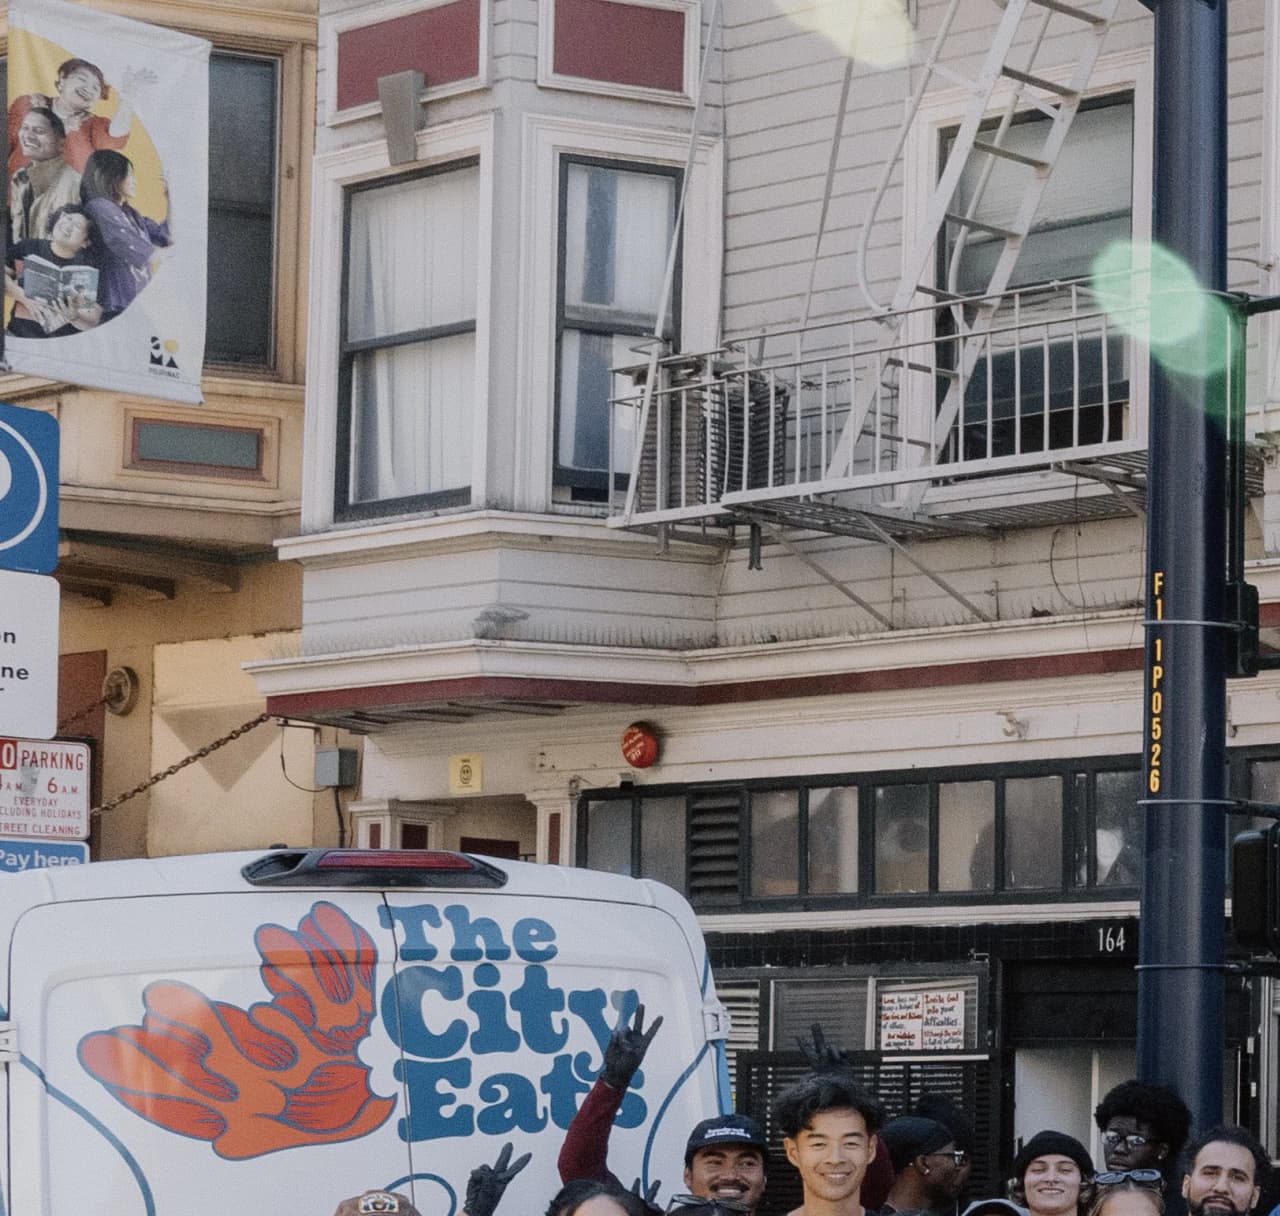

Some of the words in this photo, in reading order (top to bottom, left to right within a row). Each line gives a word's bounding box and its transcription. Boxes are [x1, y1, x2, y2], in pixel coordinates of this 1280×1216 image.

[0, 632, 16, 644] n
[1, 668, 29, 680] ne
[2, 746, 15, 768] O
[21, 750, 84, 770] PARKING
[47, 777, 58, 793] 6
[14, 796, 57, 807] EVERYDAY
[0, 807, 37, 818] CLUDING
[41, 809, 81, 820] HOLIDAYS
[0, 824, 28, 834] TREET
[32, 825, 80, 836] CLEANING
[35, 851, 79, 869] here
[378, 904, 558, 961] The
[1098, 927, 1125, 951] 164
[381, 963, 640, 1077] City
[398, 1053, 648, 1143] Eats
